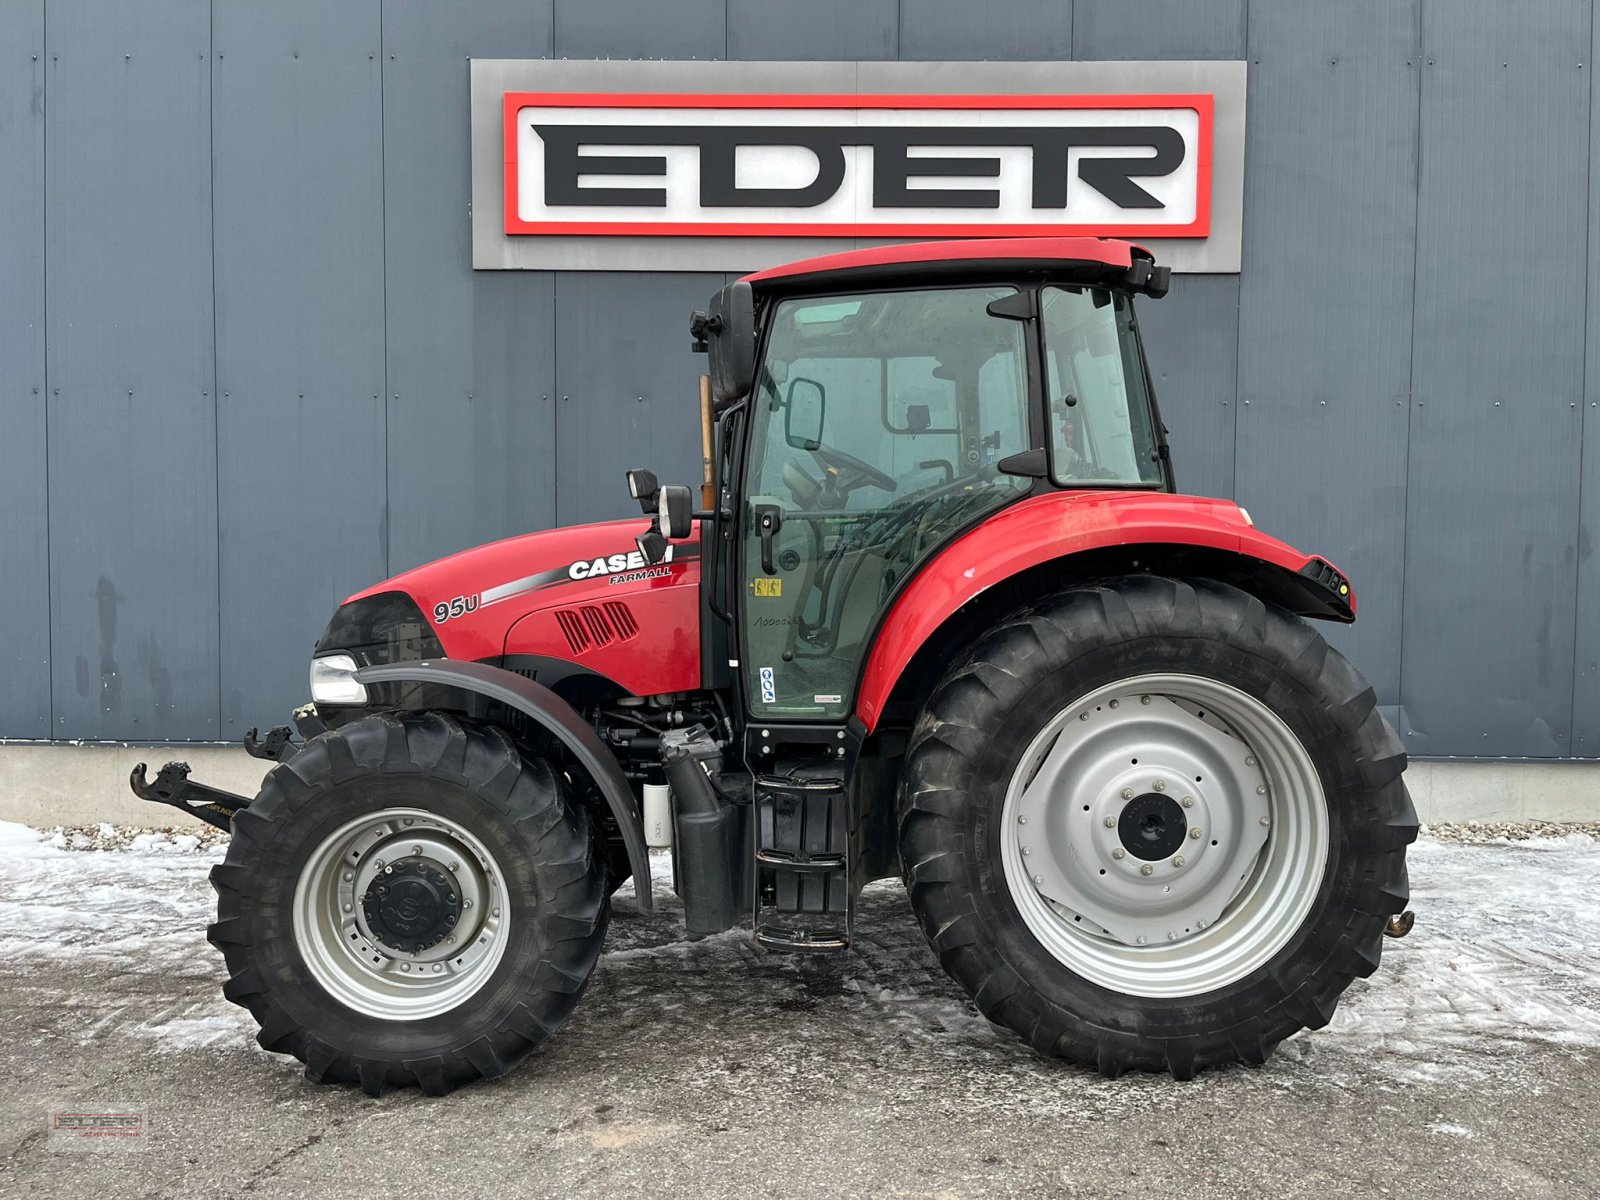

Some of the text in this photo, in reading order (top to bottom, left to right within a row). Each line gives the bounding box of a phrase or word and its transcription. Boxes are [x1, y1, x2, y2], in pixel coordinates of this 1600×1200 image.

[530, 124, 1186, 209] EDER
[569, 551, 645, 580] CASE
[609, 567, 672, 585] FARMALL
[434, 594, 479, 624] 95U
